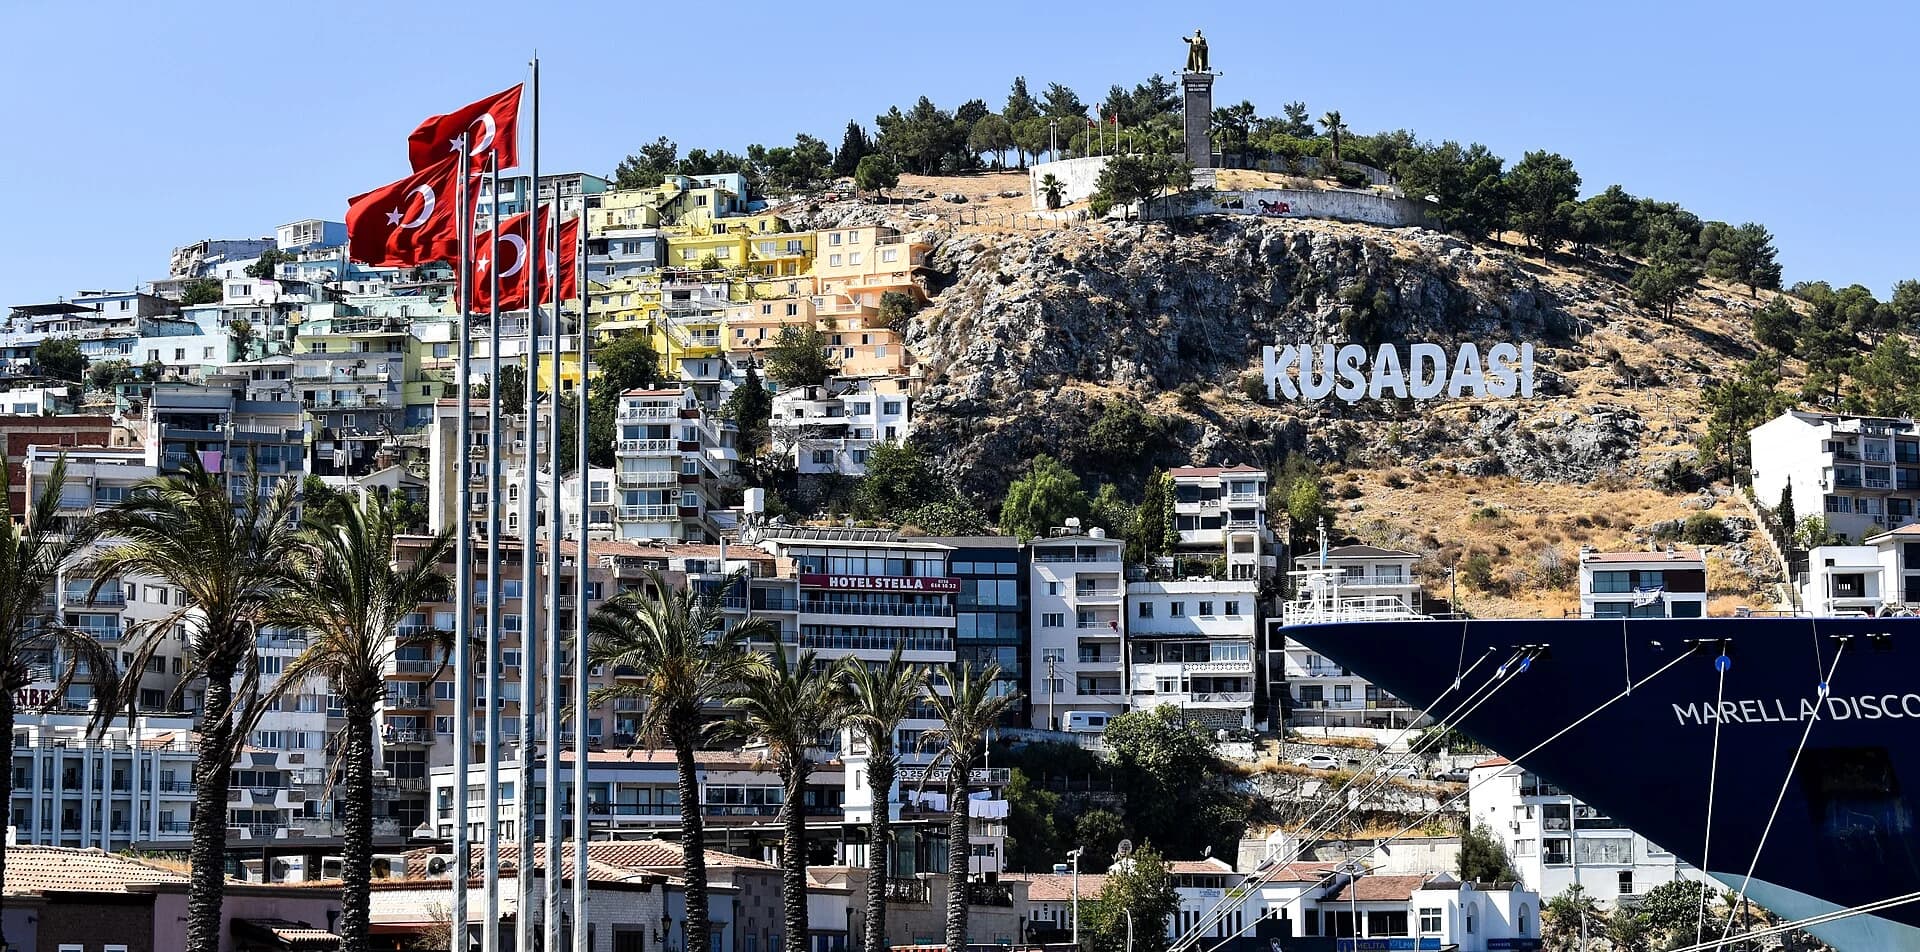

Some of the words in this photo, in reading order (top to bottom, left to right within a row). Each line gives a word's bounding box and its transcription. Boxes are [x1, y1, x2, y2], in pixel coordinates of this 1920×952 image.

[829, 576, 873, 588] HOTEL
[875, 577, 923, 589] STELLA
[1672, 698, 1821, 725] MARELLA
